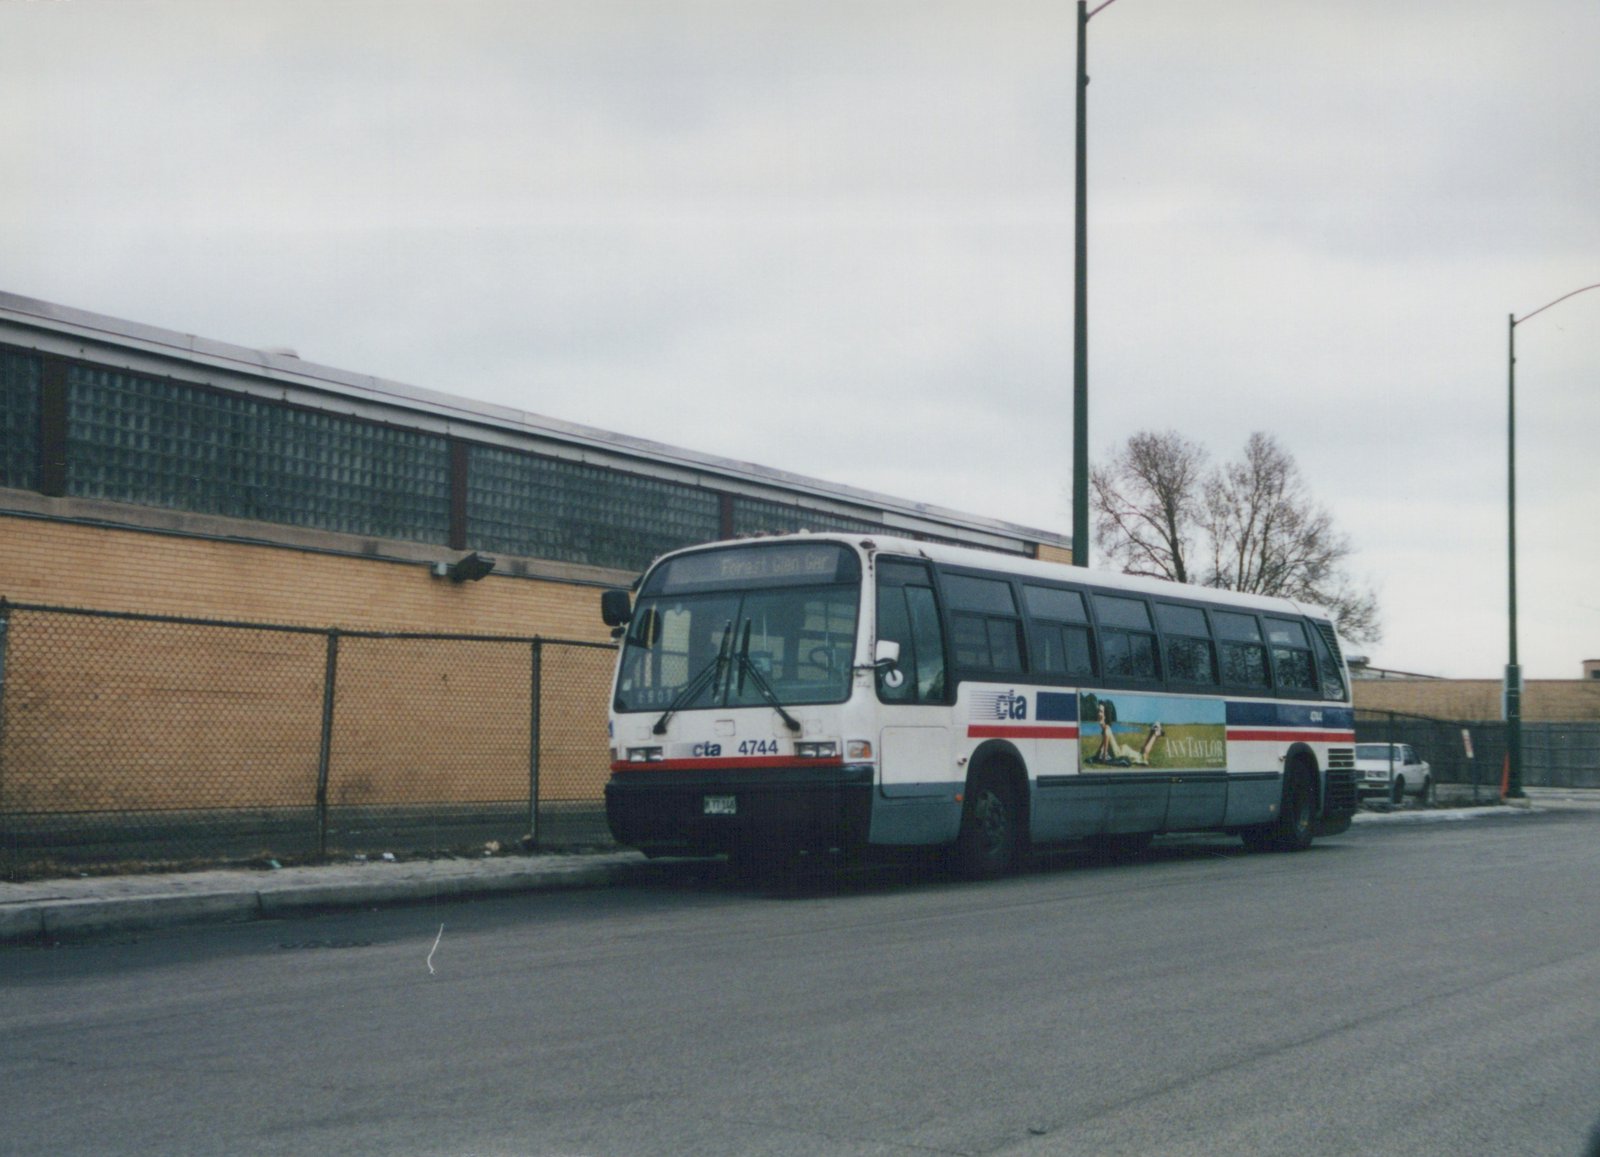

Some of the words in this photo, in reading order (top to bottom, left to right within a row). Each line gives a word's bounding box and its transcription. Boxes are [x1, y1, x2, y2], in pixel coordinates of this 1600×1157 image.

[996, 689, 1027, 720] cta
[693, 739, 722, 757] cta
[738, 738, 780, 756] 4744
